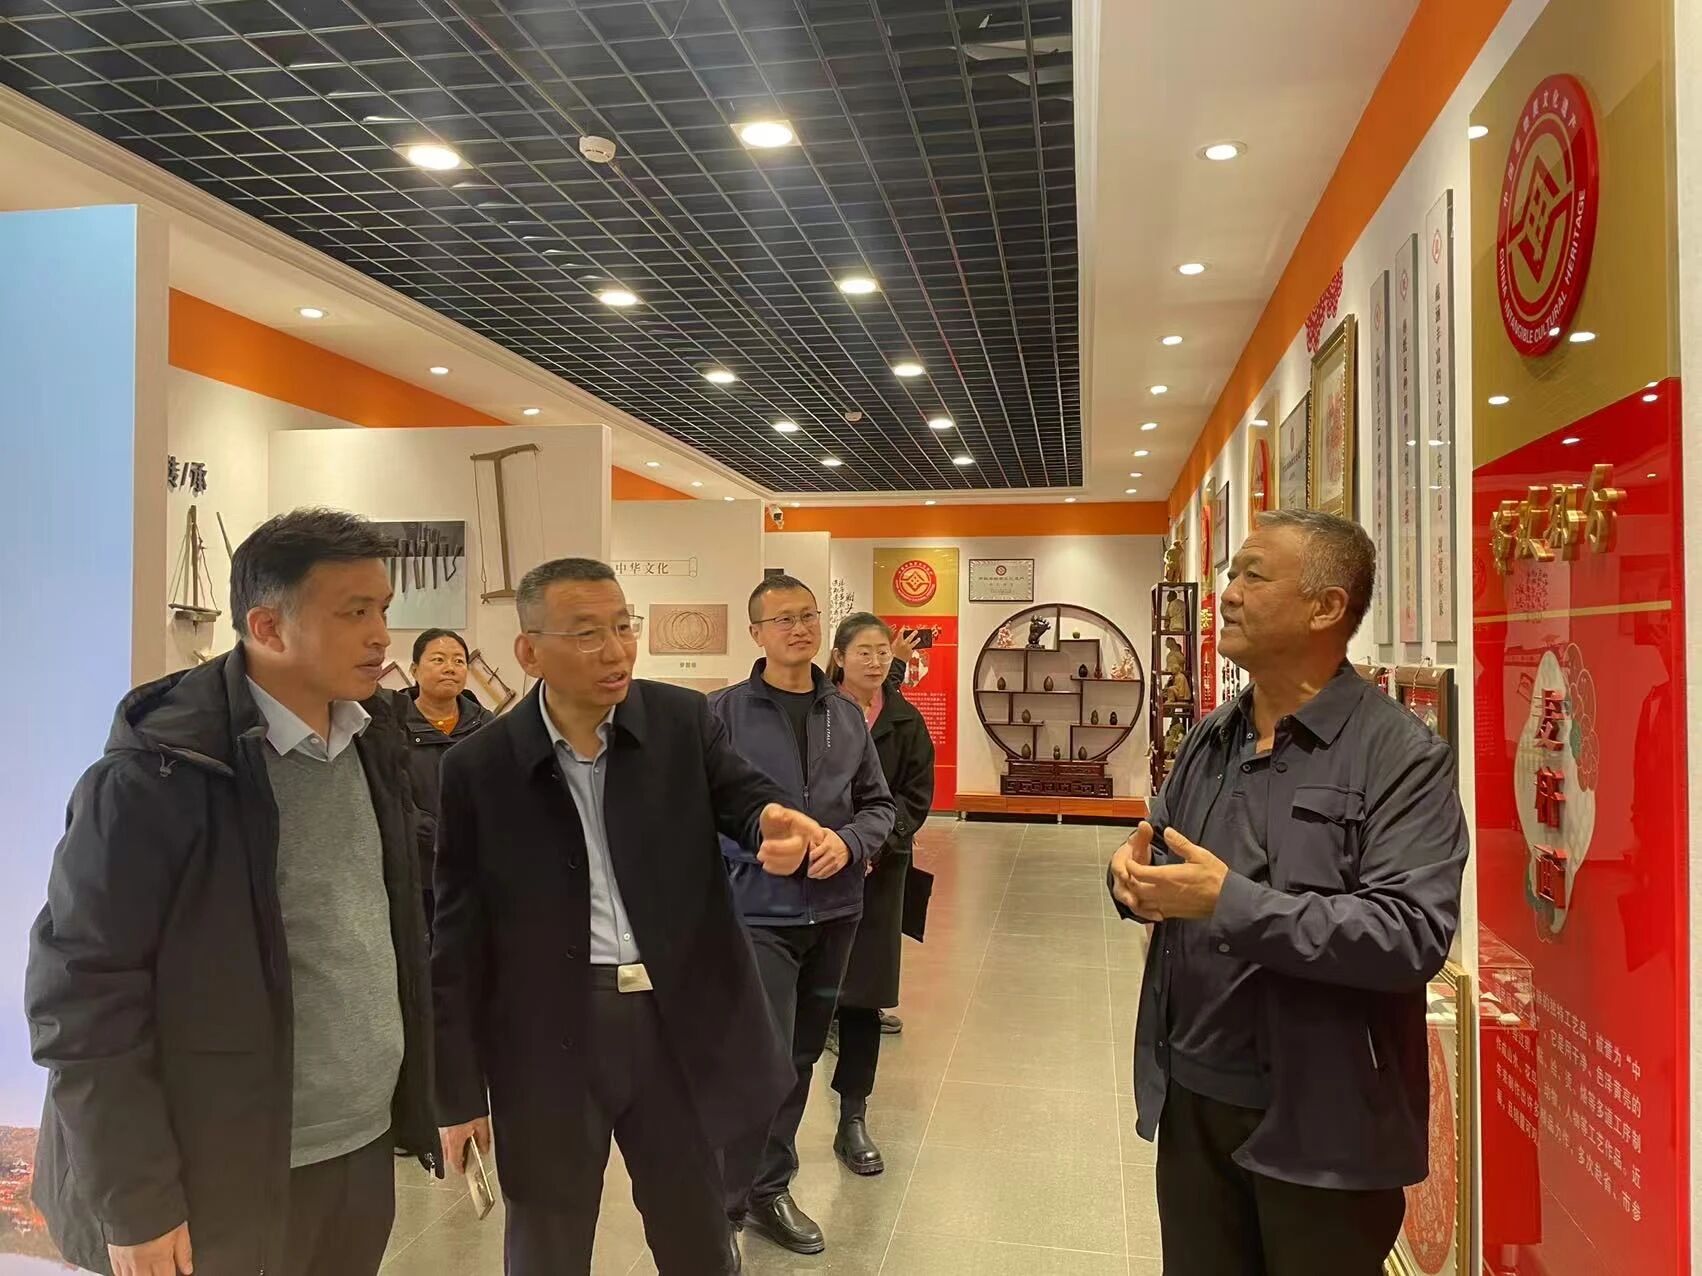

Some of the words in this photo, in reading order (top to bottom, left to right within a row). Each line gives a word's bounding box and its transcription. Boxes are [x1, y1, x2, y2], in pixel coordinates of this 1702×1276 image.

[1499, 248, 1508, 298] CHINA
[1504, 300, 1534, 343] INTANGIBLE
[1534, 291, 1567, 343] CULTURAL
[1565, 188, 1586, 285] HERITAGE
[615, 562, 669, 574] 中华文化
